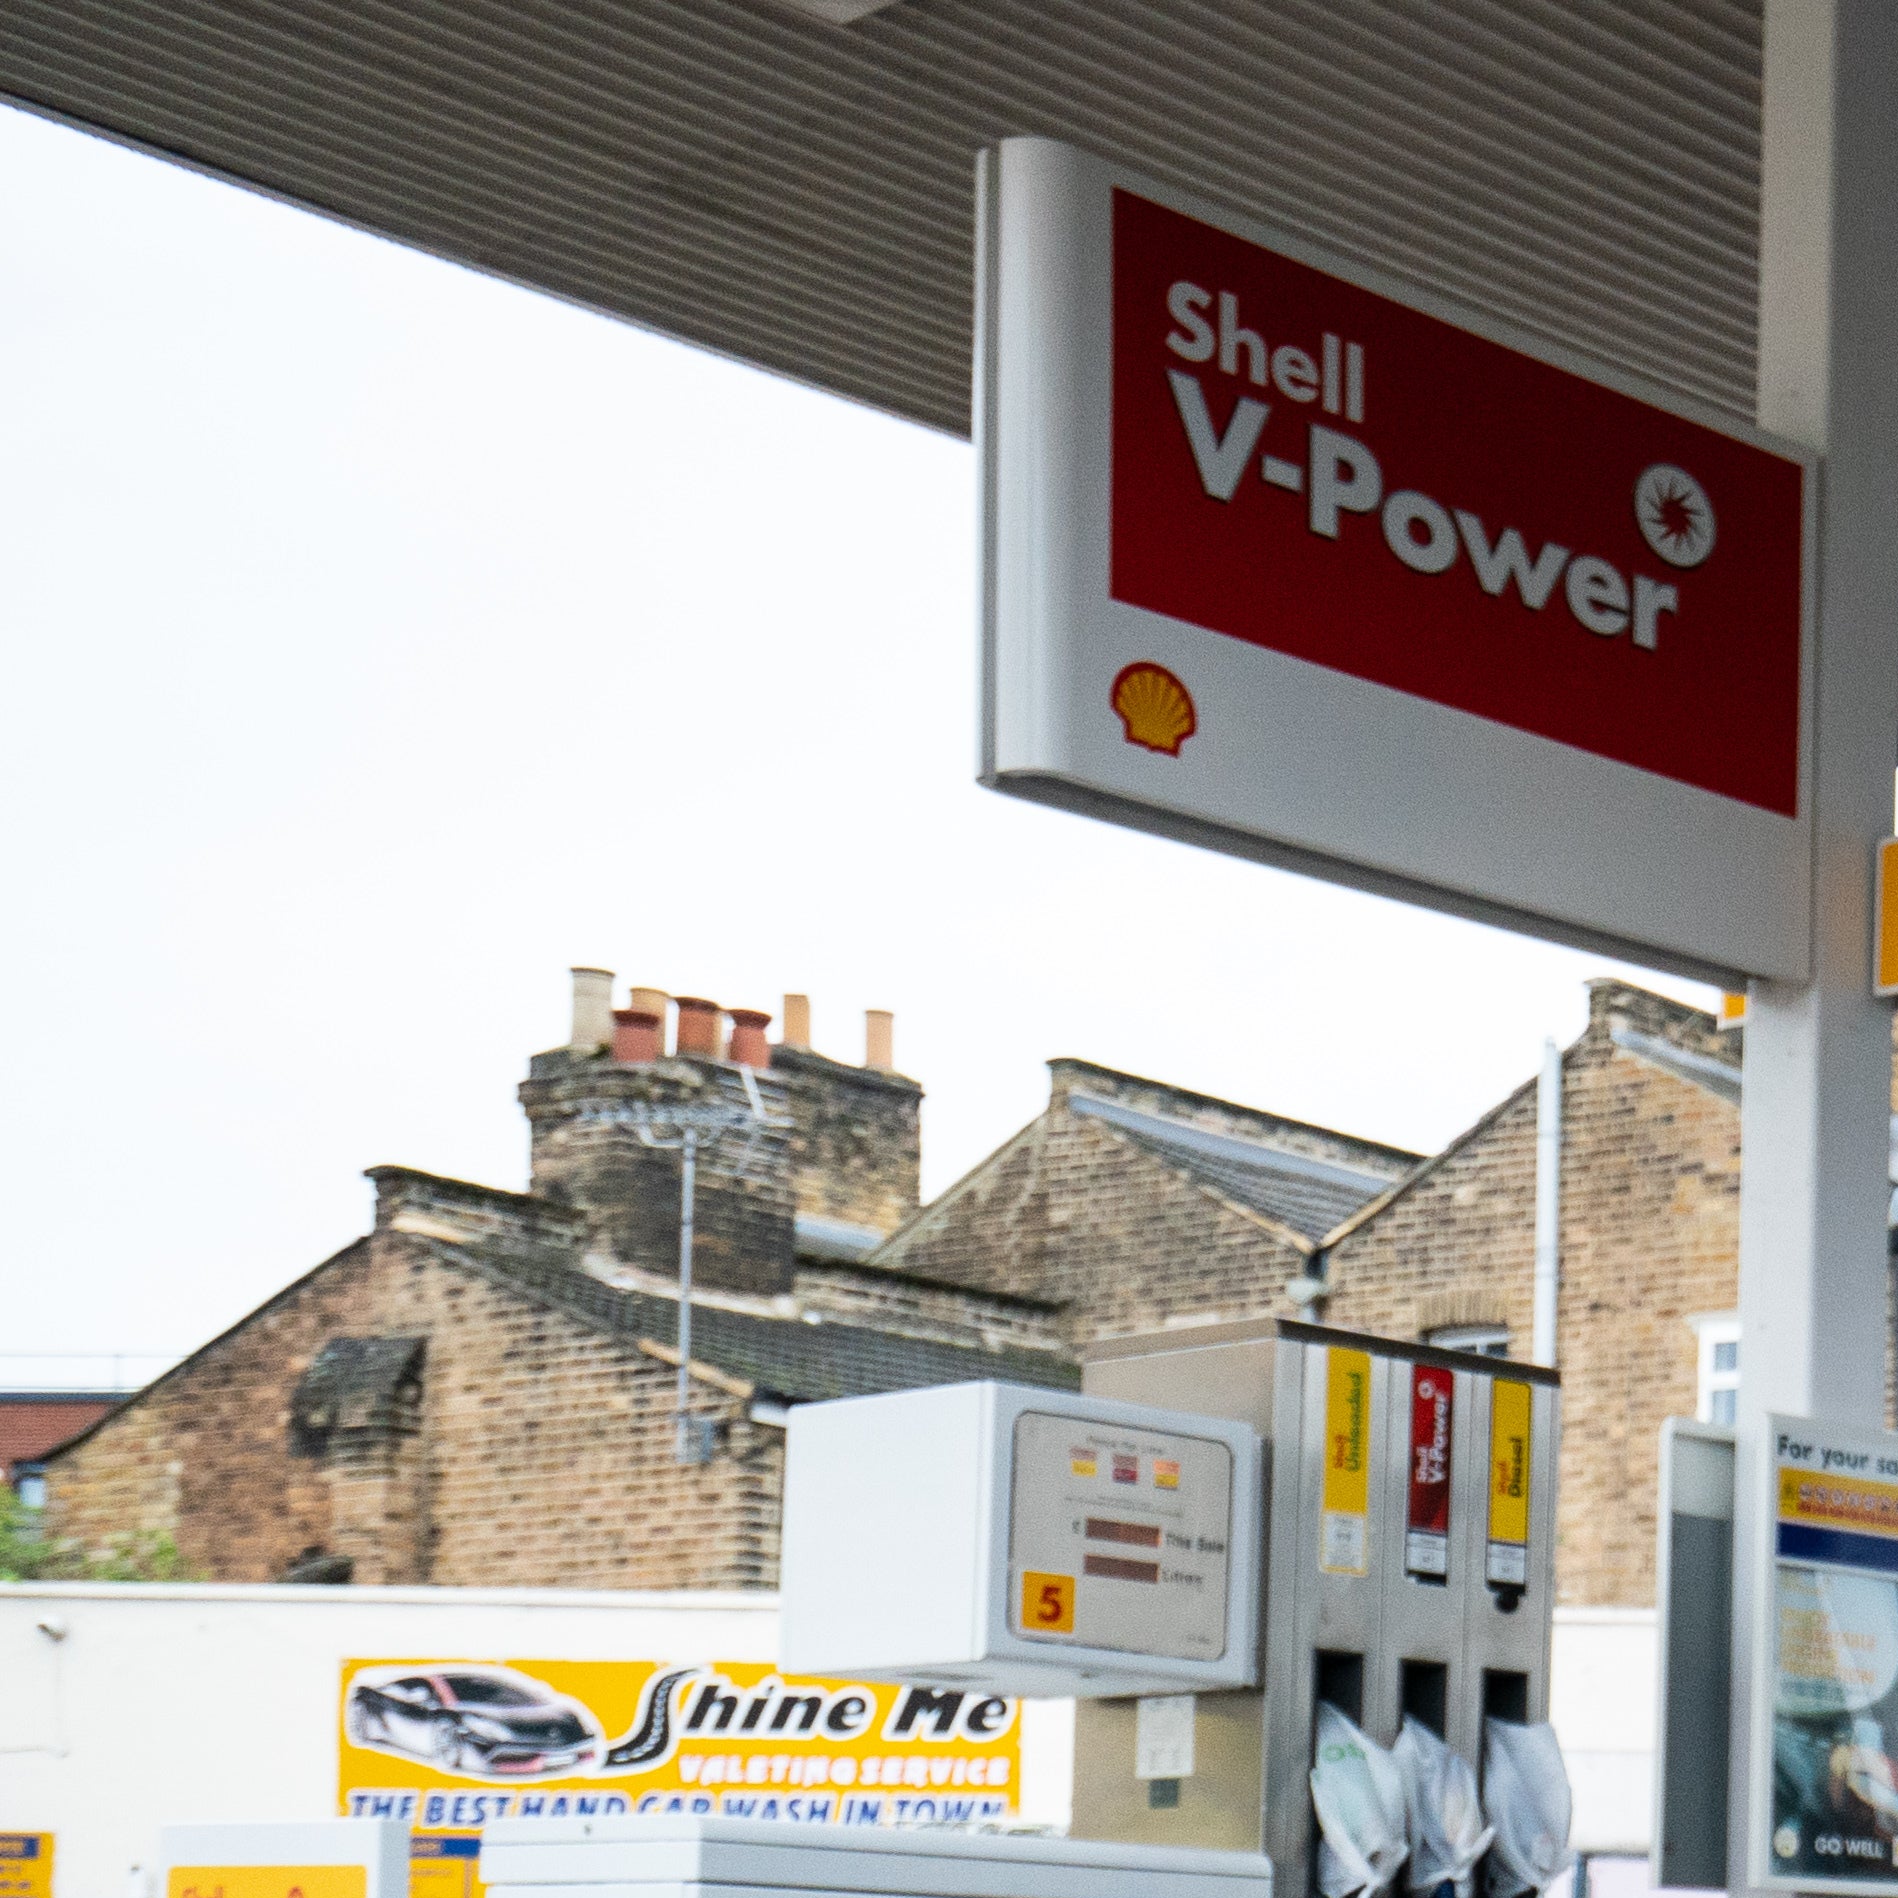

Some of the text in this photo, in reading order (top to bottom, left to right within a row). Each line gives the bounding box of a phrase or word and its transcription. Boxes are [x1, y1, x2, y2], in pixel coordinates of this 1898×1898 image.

[1164, 280, 1366, 423] Shell
[1166, 368, 1678, 652] V-Power
[1345, 1371, 1363, 1472] Unleaded
[1428, 1391, 1448, 1483] V-Power
[1776, 1434, 1812, 1460] For
[1820, 1448, 1869, 1470] your
[1508, 1436, 1524, 1498] Diesel
[1037, 1584, 1063, 1624] 5
[604, 1669, 1008, 1768] Shine Me
[860, 1756, 1011, 1787] SERVICE
[352, 1794, 1004, 1827] THE BEST HAND CAR WASH IN TOWN
[1814, 1835, 1885, 1860] GO WELL
